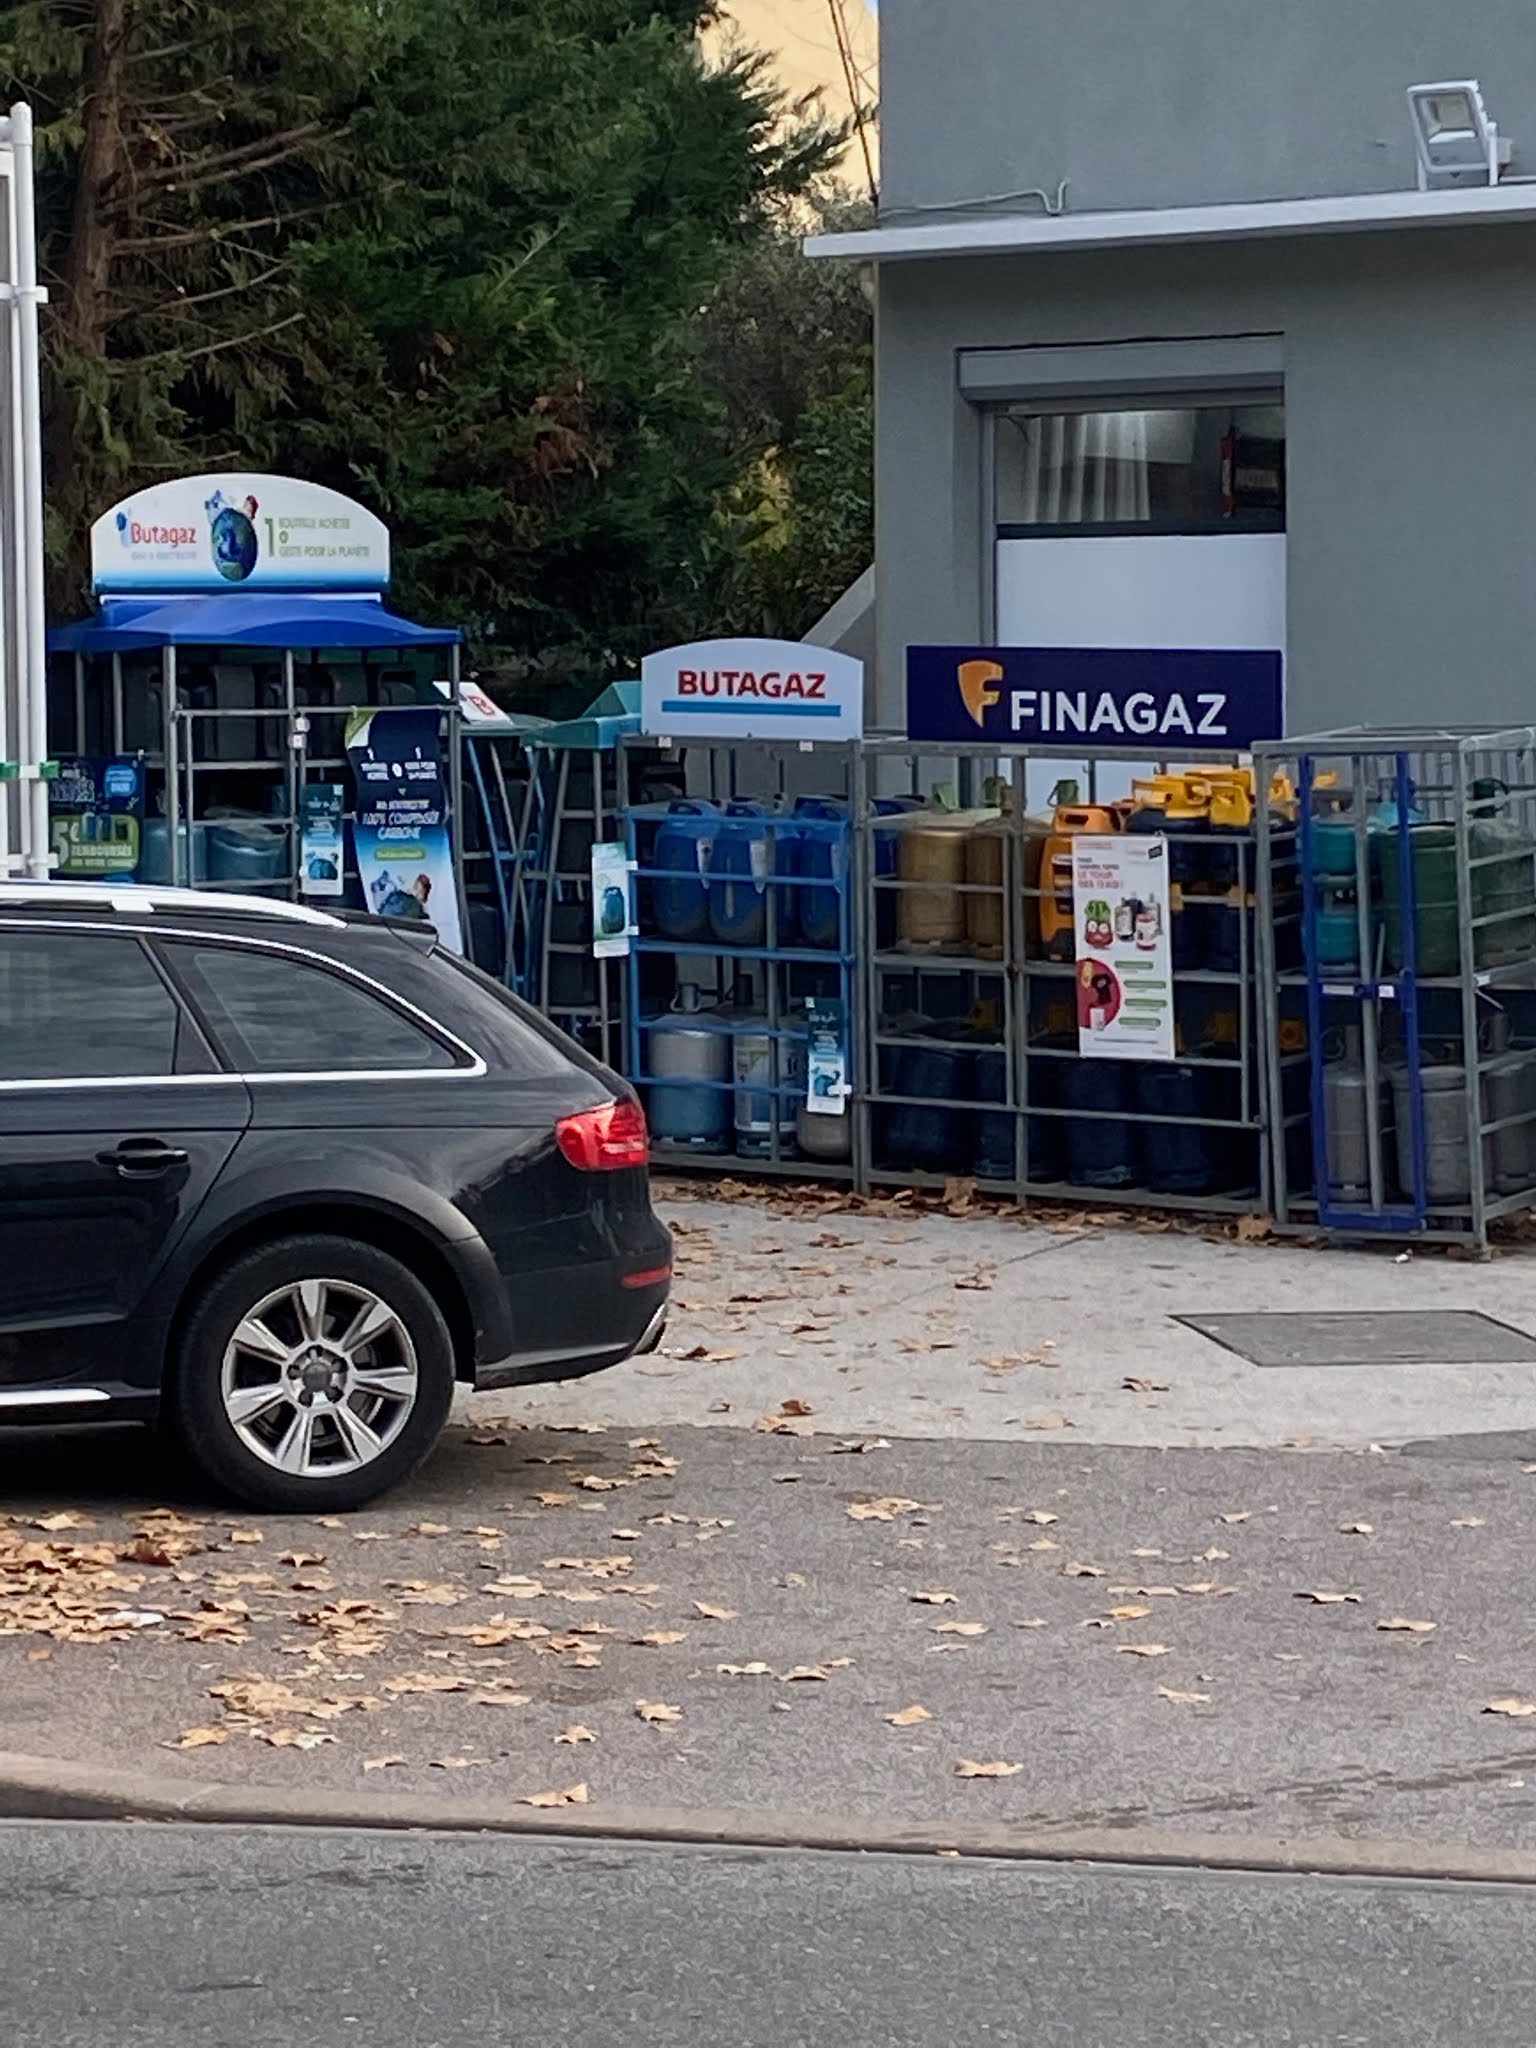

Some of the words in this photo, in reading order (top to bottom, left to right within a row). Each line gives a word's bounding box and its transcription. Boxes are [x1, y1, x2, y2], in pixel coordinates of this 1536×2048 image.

[131, 522, 197, 548] Butagaz
[678, 670, 826, 699] BUTAGAZ
[1011, 690, 1227, 735] FINAGAZ
